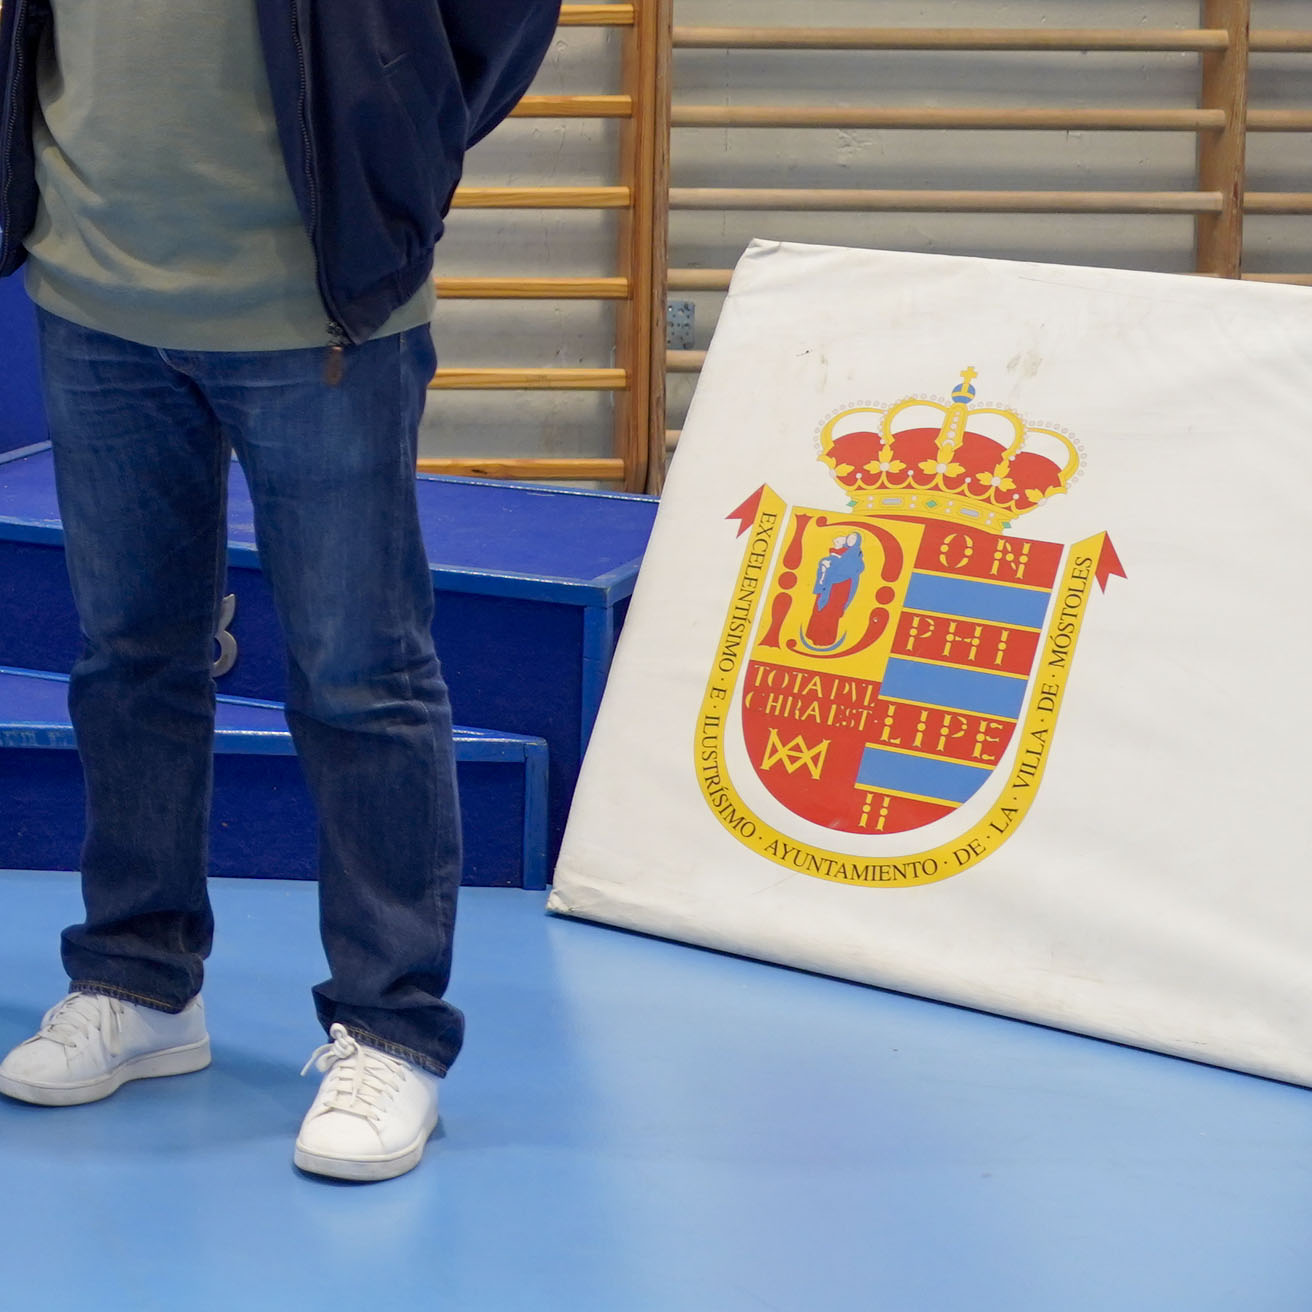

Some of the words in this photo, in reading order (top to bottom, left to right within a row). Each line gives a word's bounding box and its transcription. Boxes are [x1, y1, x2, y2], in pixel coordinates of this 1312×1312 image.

[718, 512, 777, 673] EXCELENTÍSIMO
[1047, 555, 1094, 669] MÓSTOLES
[710, 688, 727, 701] E
[1037, 683, 1060, 714] DE
[701, 715, 756, 839] ILUSTRÍSIMO
[1012, 728, 1049, 791] VILLA
[989, 806, 1019, 835] LA
[764, 838, 938, 882] AYUNTAMIENTO
[952, 838, 987, 867] DE
